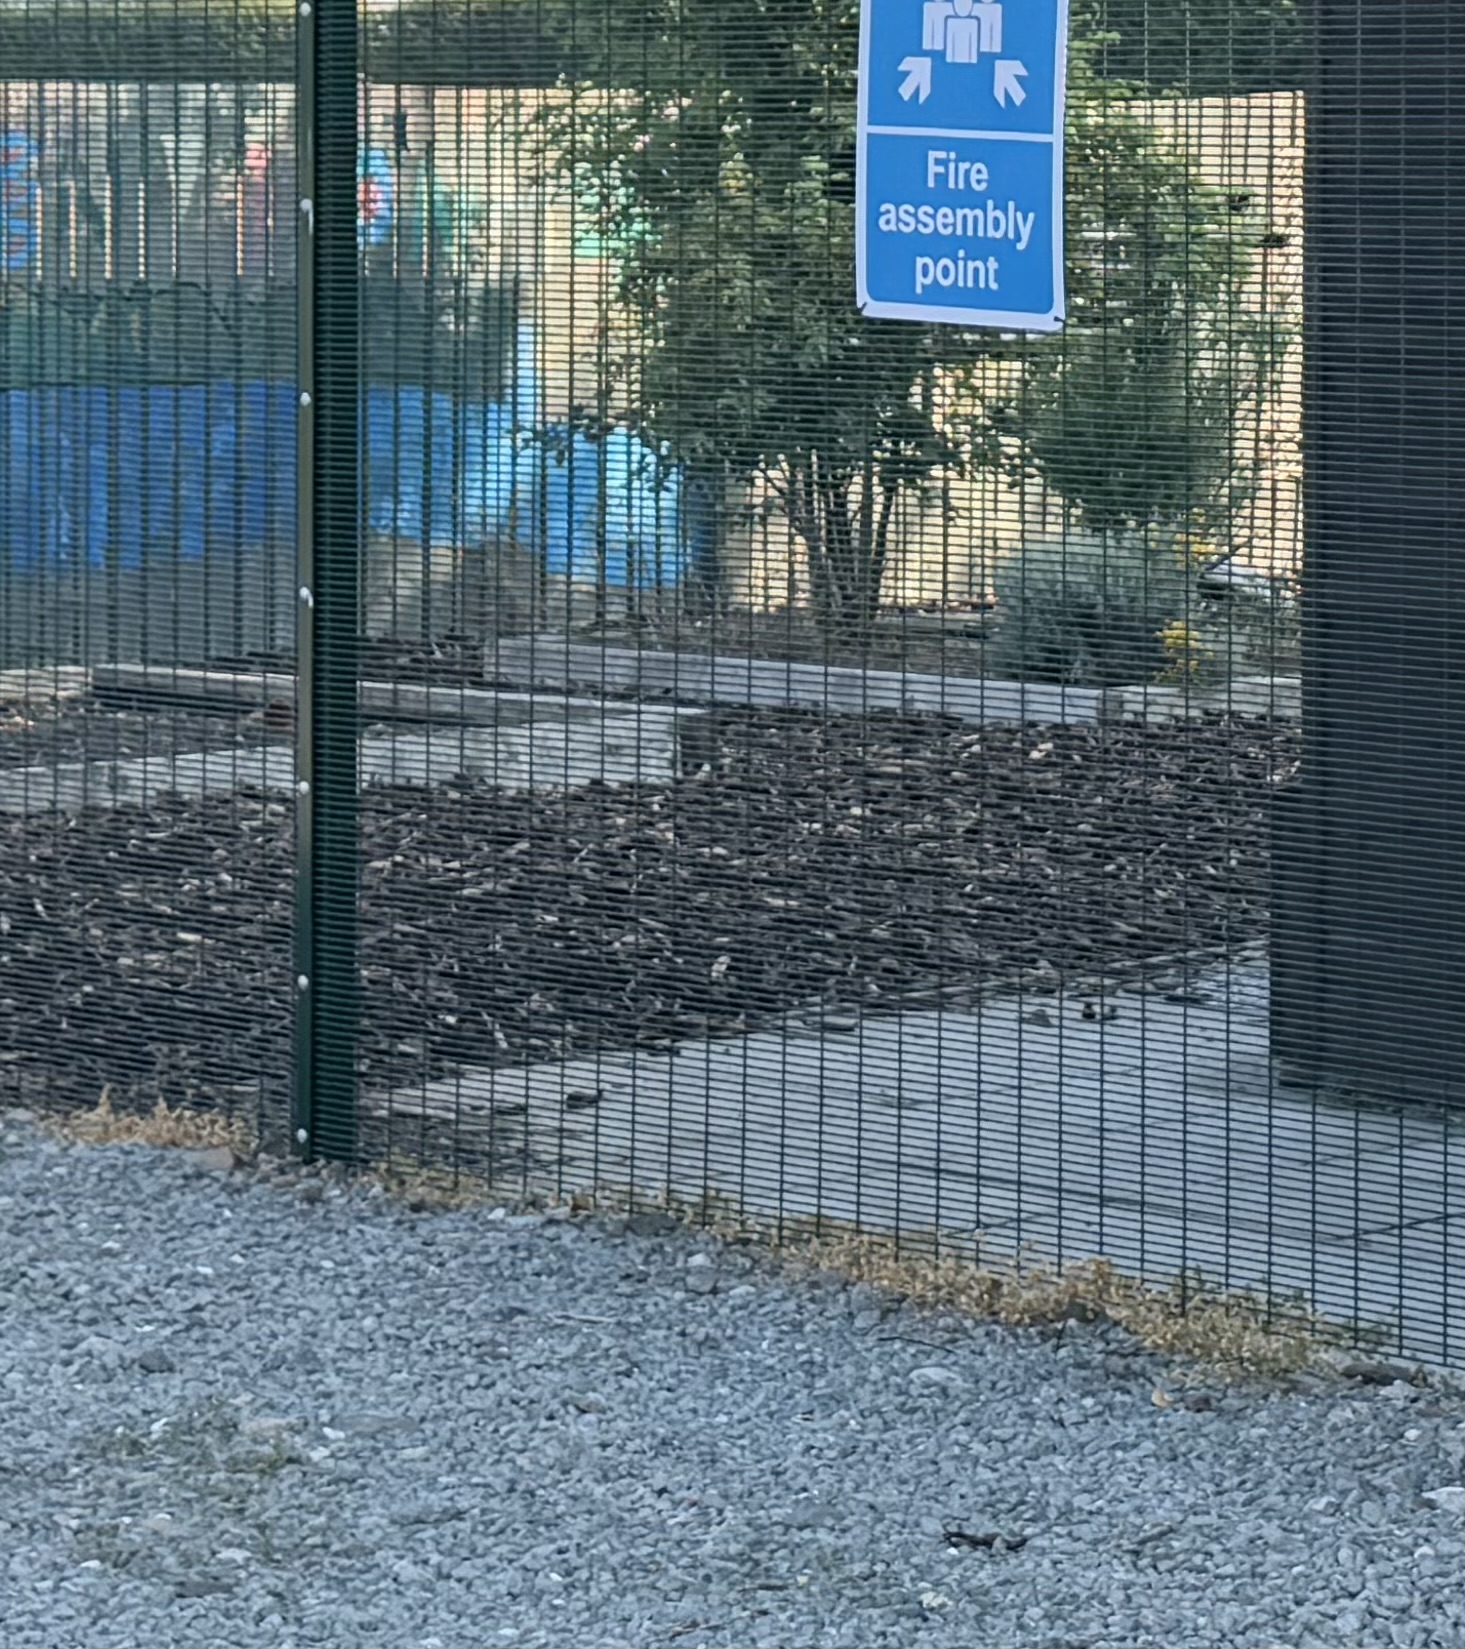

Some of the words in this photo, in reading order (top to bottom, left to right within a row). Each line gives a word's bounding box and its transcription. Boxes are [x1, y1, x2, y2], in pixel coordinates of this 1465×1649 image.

[927, 150, 989, 192] Fire
[878, 199, 1035, 250] assembly
[915, 249, 999, 295] point
